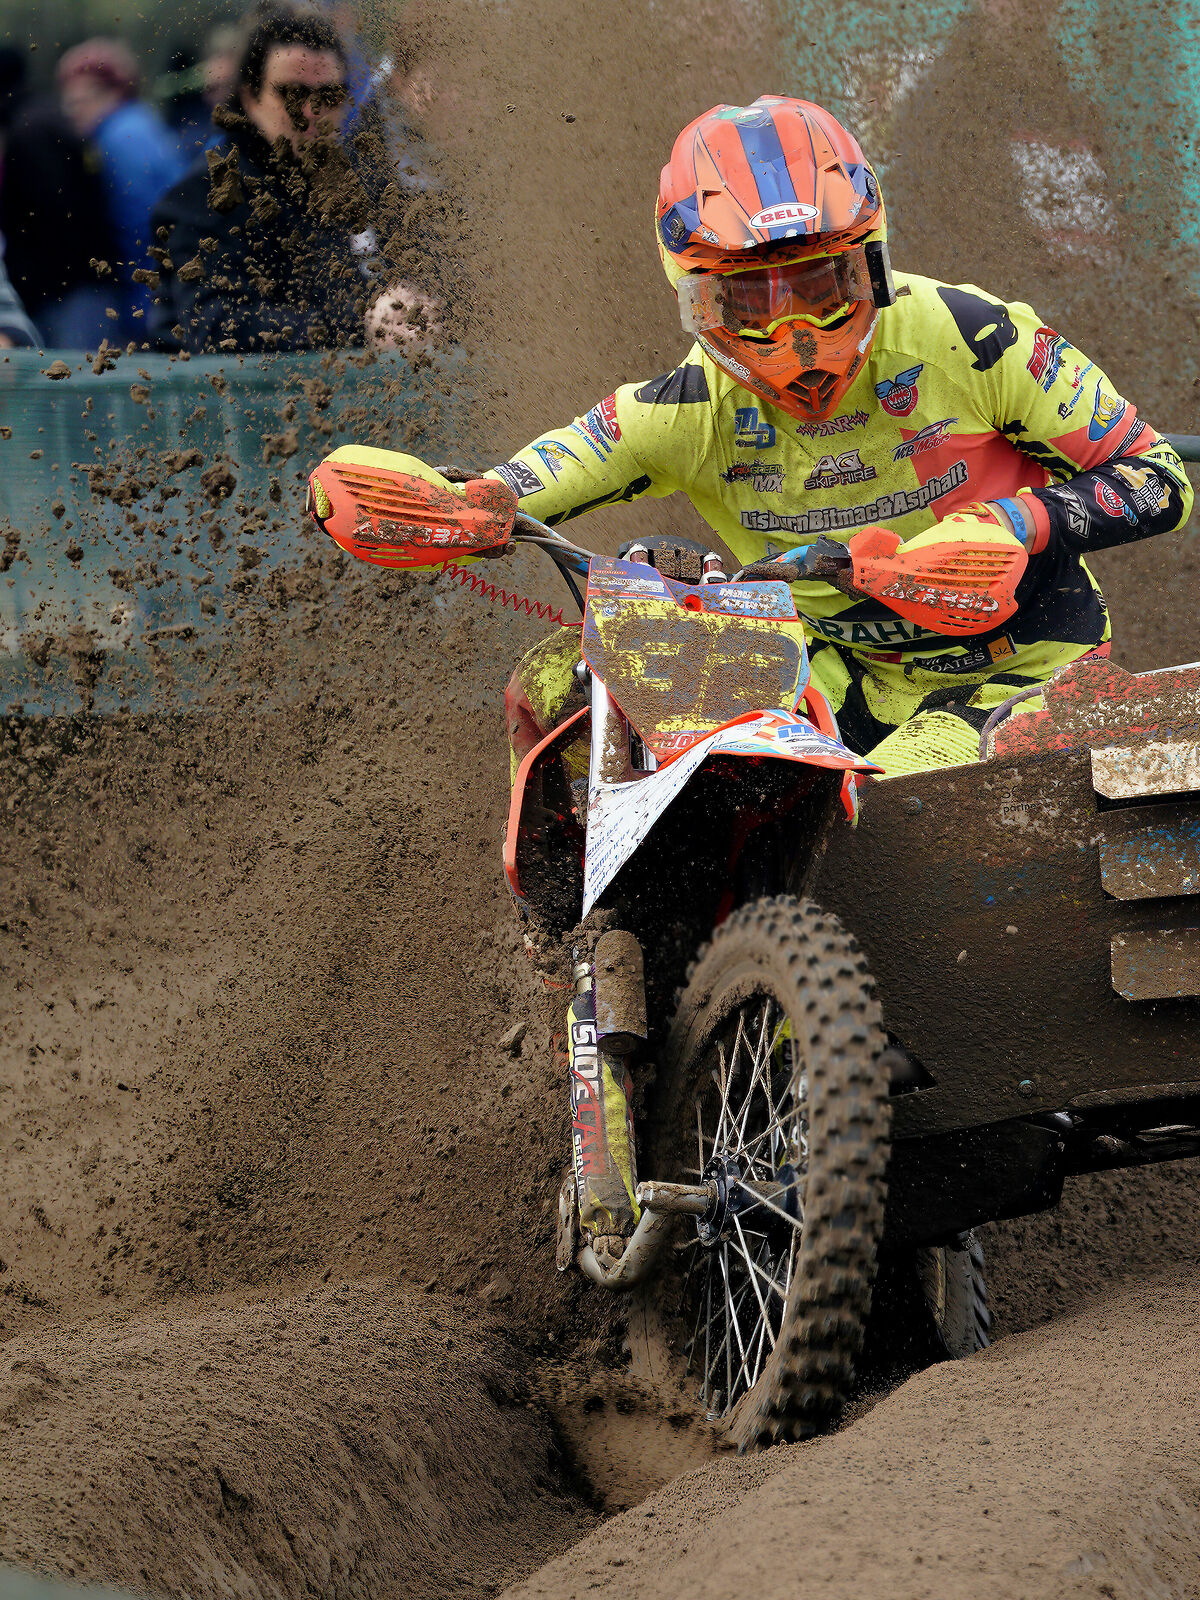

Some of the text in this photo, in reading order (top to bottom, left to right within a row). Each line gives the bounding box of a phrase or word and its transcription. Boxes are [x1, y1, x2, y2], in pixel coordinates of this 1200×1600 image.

[760, 208, 809, 224] BELL
[804, 466, 877, 491] SKIP HIRE
